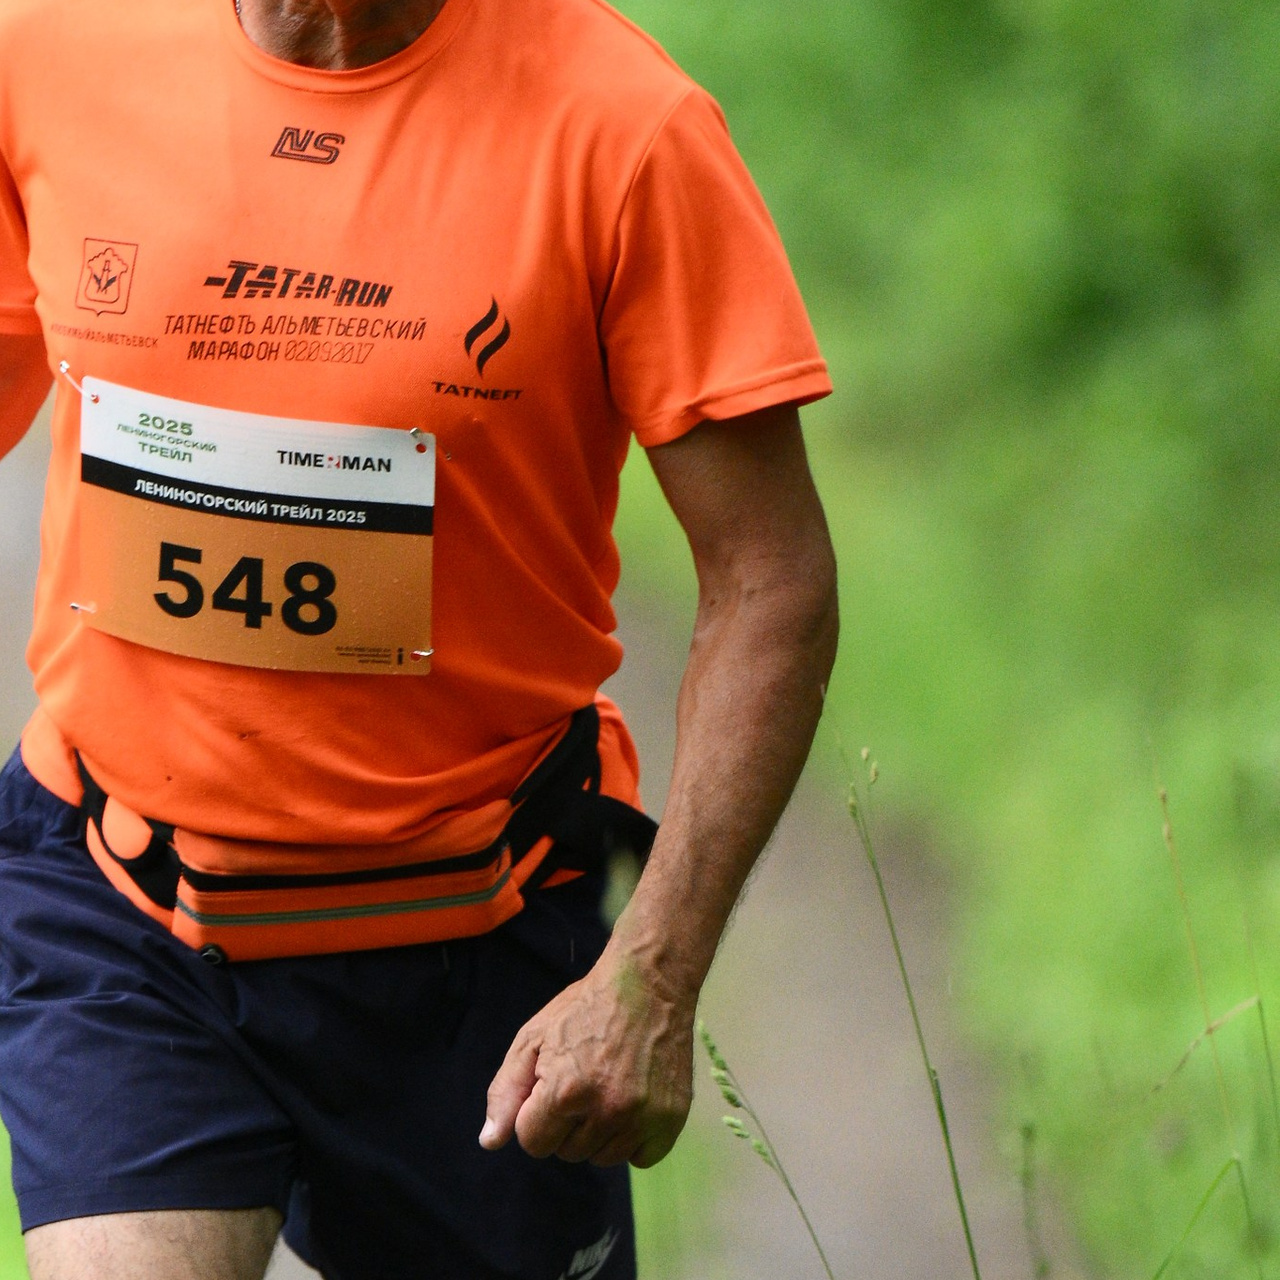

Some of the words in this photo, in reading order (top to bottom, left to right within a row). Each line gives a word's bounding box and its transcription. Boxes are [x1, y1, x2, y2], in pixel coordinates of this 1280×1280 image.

[270, 126, 346, 165] NS
[164, 314, 256, 335] ТАТНЕФТЬ
[260, 315, 427, 341] АЛЬМЕТЬЕВСКИЙ
[186, 339, 281, 361] МАРАФОН
[431, 381, 523, 400] TATNEFT
[116, 423, 218, 453] ЛЕНИНОГОРСКИЙ
[138, 413, 193, 436] 2025
[138, 441, 193, 463] ТРЕЙЛ
[134, 478, 268, 516] ЛЕНИНОГОРСКИЙ
[270, 503, 323, 521] ТРЕЙЛ
[326, 508, 367, 524] 2025
[153, 541, 338, 636] 548
